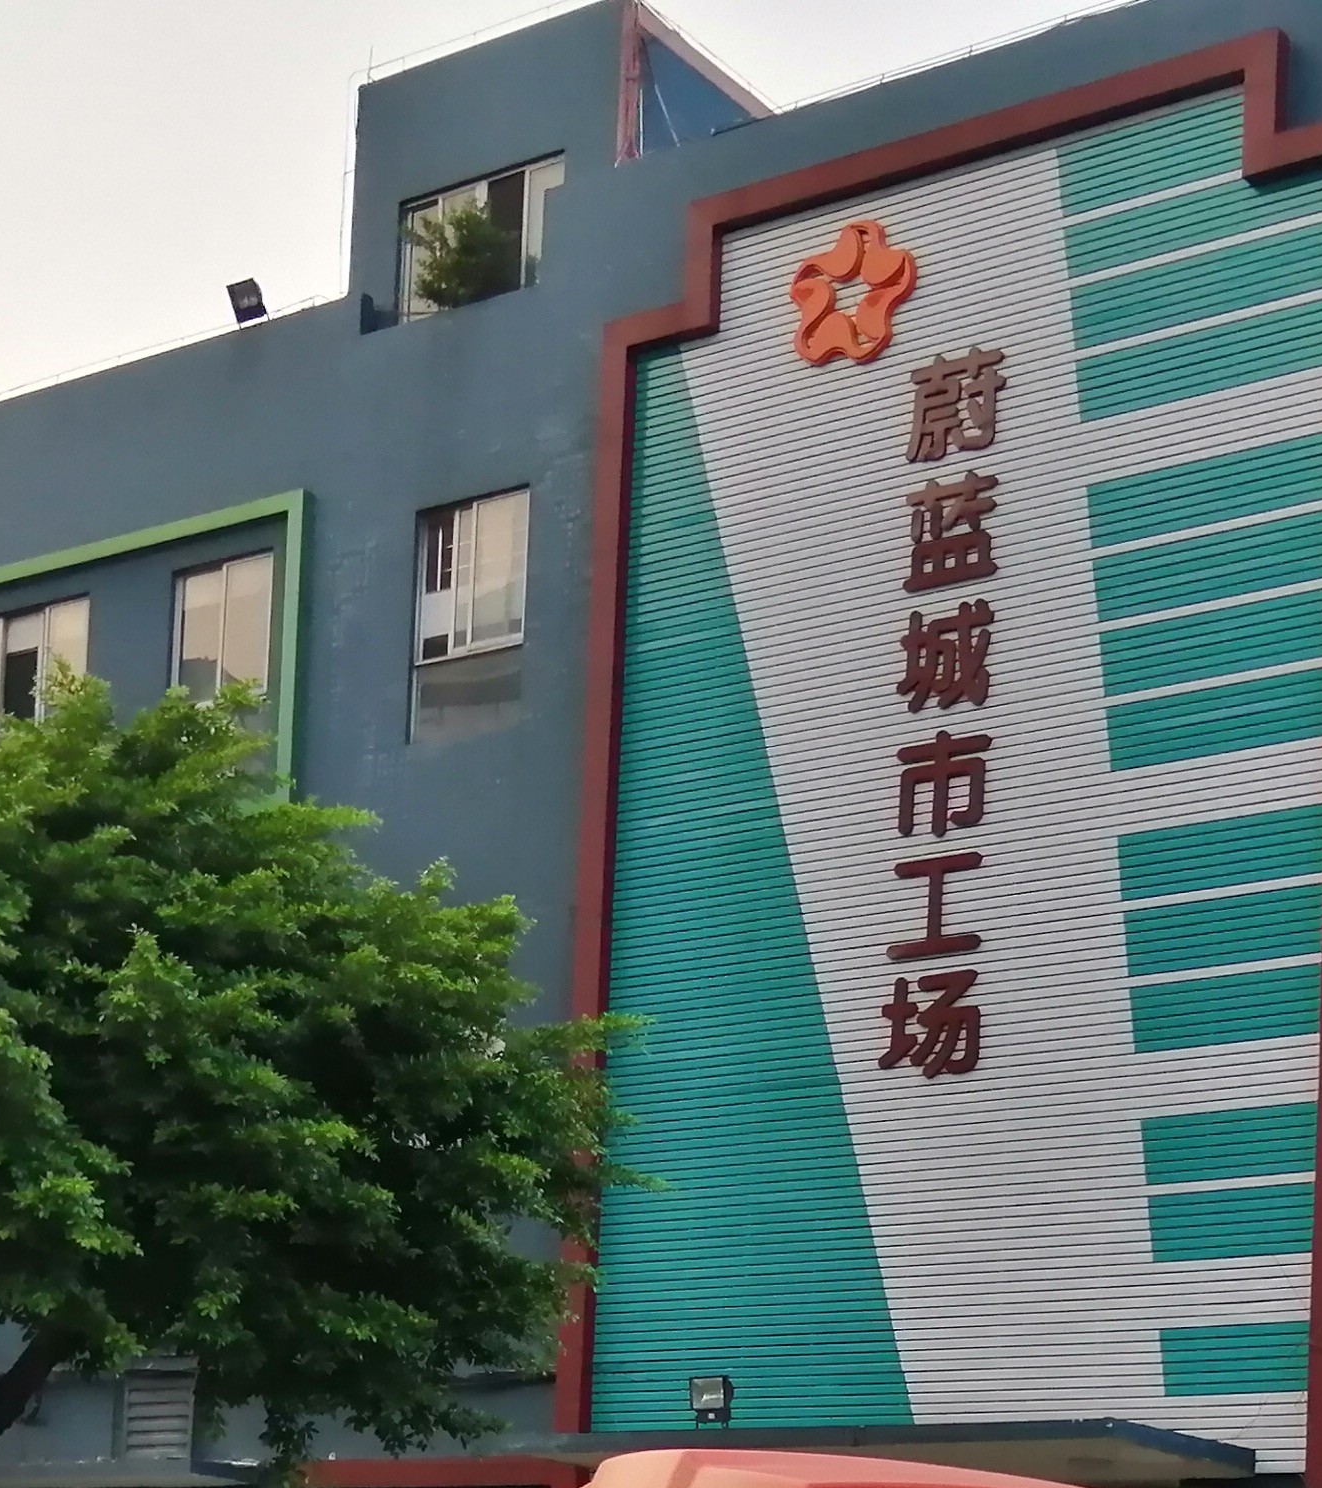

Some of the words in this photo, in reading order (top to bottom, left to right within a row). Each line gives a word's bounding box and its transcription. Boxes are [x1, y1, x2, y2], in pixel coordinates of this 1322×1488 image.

[878, 347, 1007, 1080] 蔚蓝城市工场
